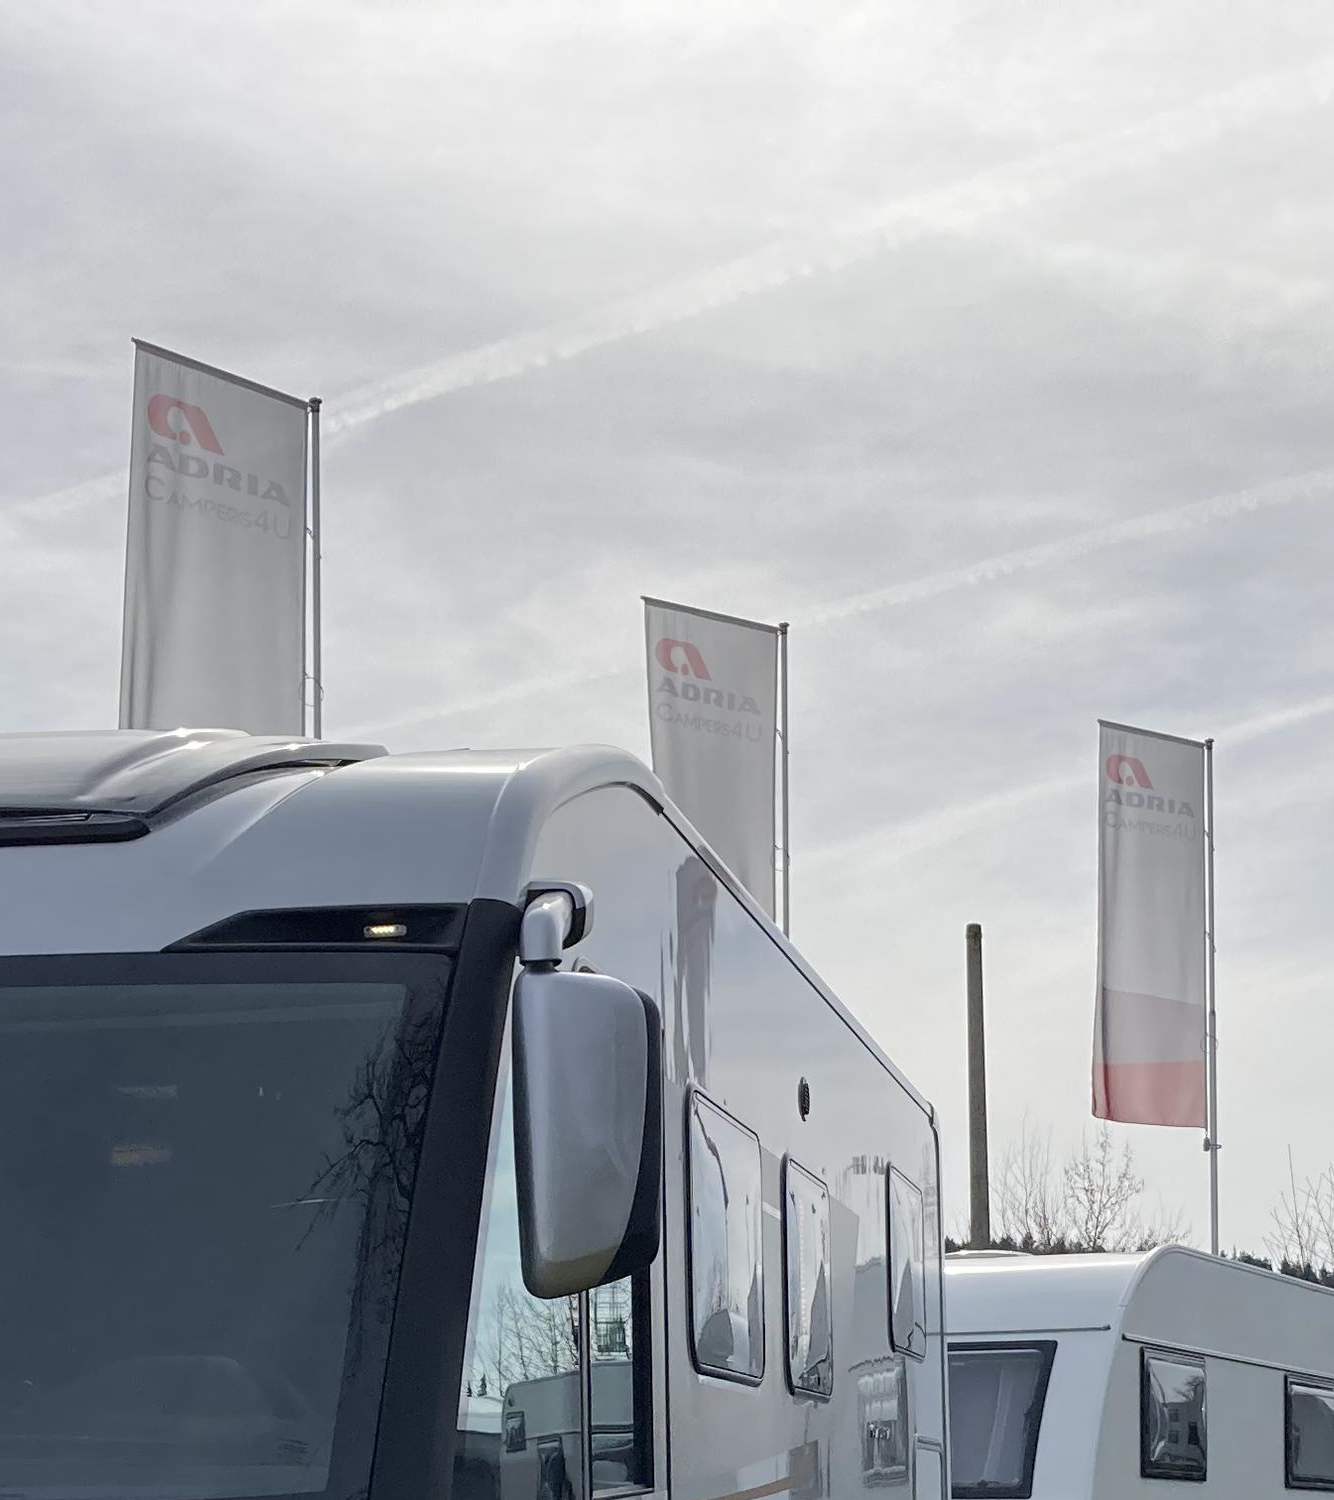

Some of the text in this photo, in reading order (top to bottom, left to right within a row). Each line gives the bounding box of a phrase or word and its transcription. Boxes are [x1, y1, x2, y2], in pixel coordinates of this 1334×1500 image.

[146, 443, 291, 508] ADRIA
[656, 677, 762, 716] ADRIA
[1105, 788, 1195, 818] ADRIA
